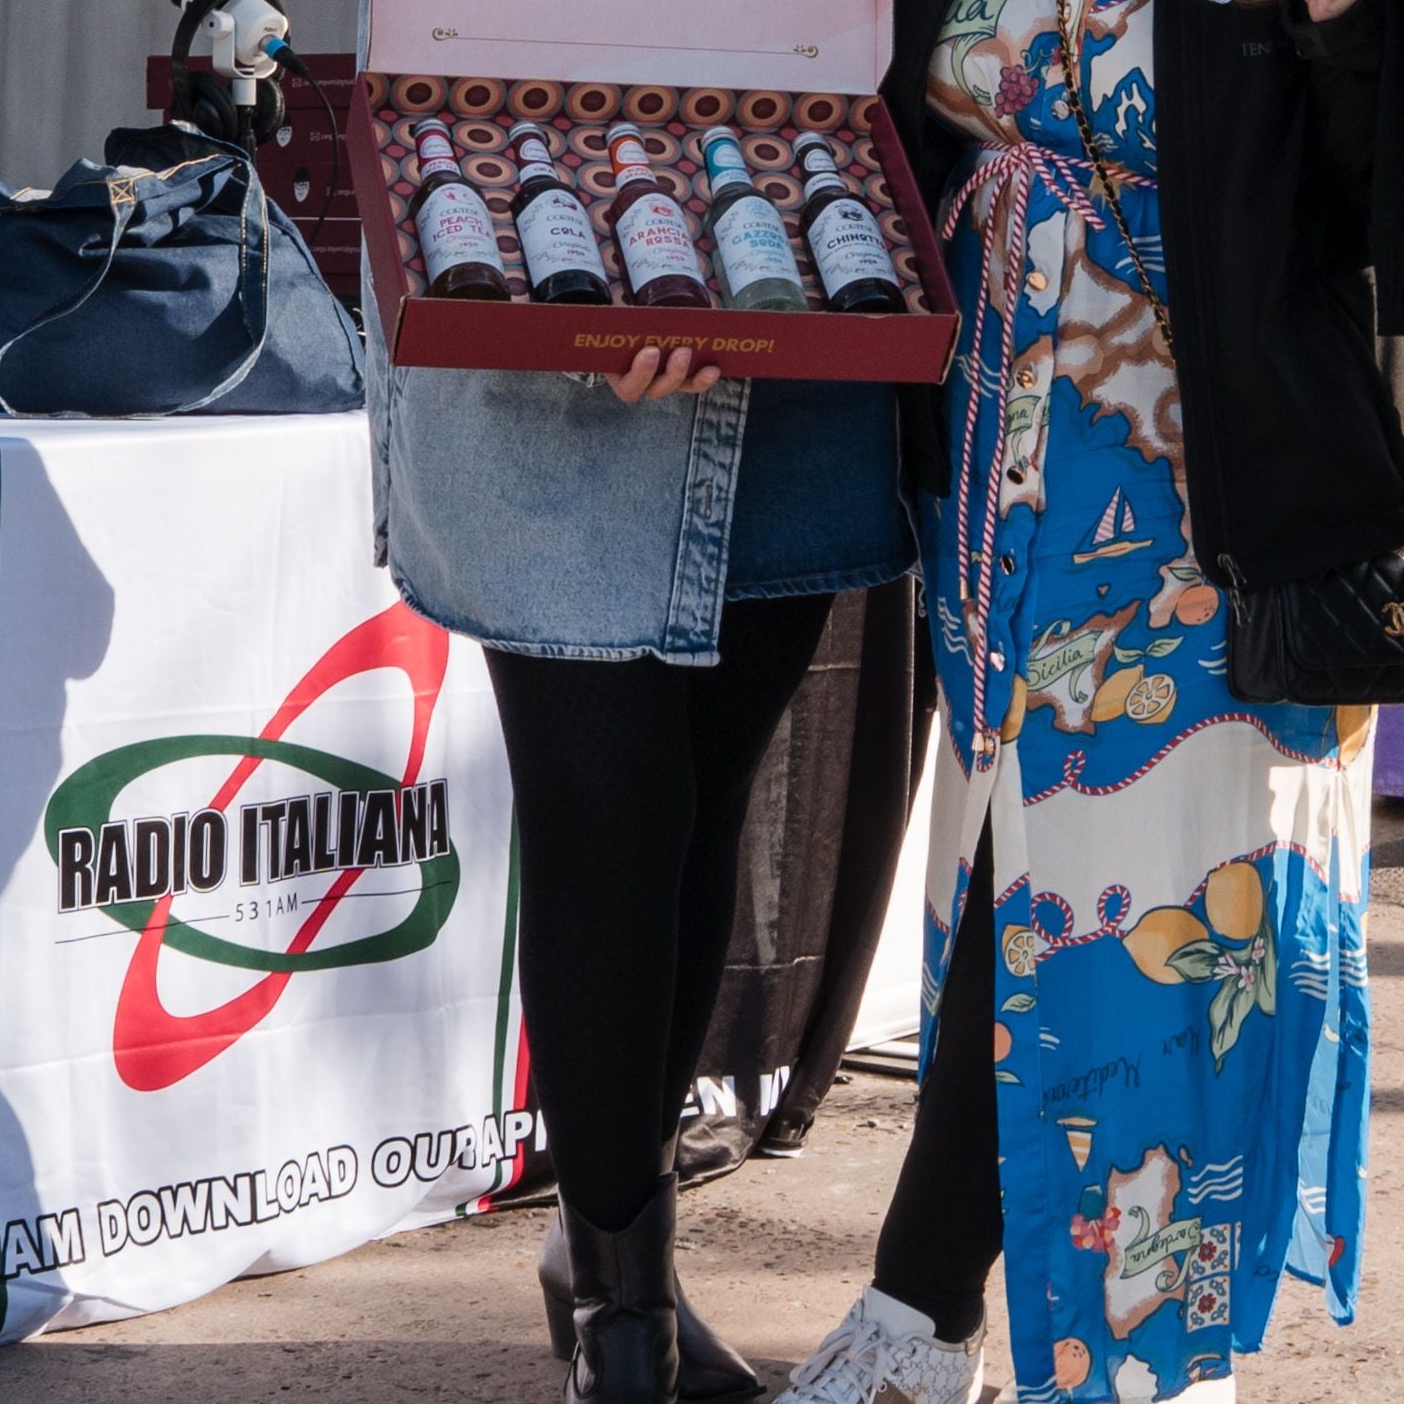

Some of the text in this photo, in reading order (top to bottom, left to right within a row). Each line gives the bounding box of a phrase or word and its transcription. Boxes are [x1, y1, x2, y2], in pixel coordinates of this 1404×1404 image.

[439, 215, 483, 228] PEACH
[432, 225, 463, 242] ICED
[550, 226, 587, 240] COLA
[574, 333, 776, 354] ENJOY EVERY DROP!
[57, 777, 452, 914] RADIO ITALIANA
[234, 892, 299, 924] 531AM
[98, 1142, 359, 1258] DOWNLOAD
[371, 1124, 478, 1188] OUR
